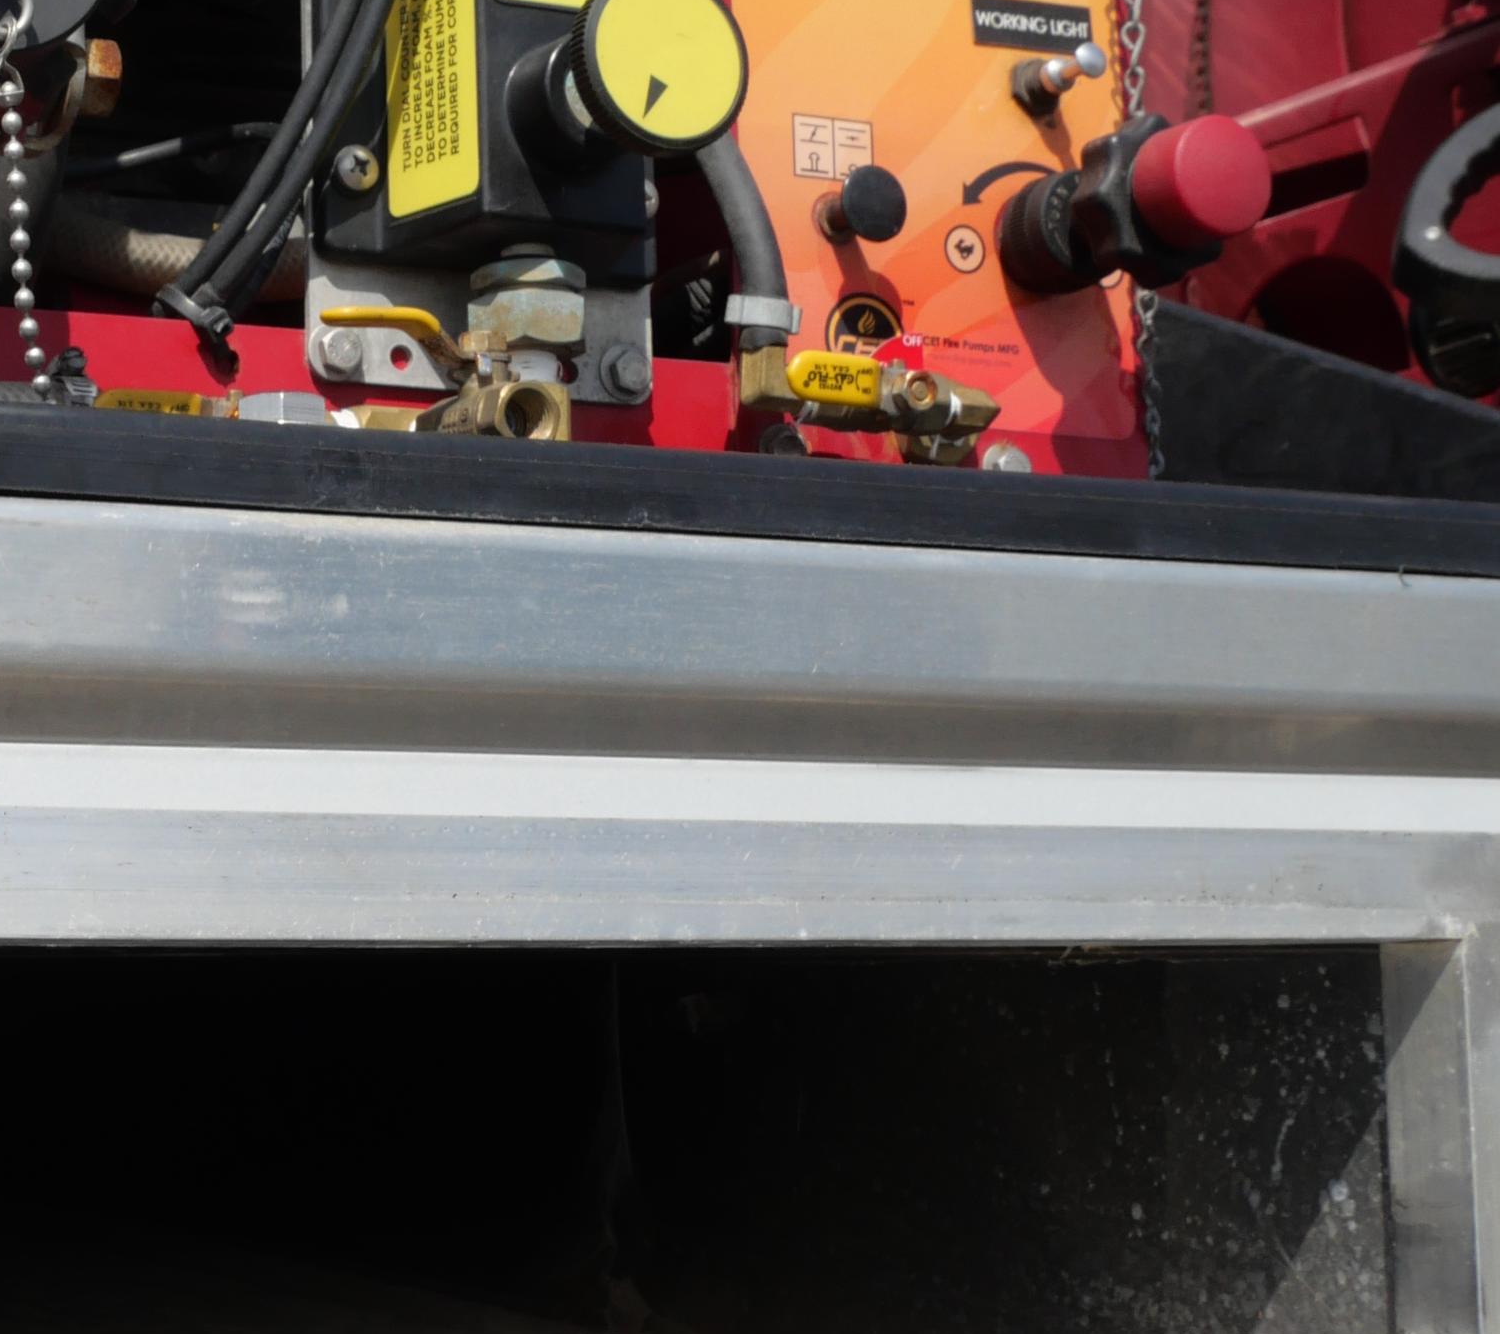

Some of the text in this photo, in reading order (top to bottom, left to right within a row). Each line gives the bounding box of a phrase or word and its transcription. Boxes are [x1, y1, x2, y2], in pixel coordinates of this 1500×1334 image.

[400, 5, 411, 82] COUNTER
[974, 9, 1089, 39] WORKING LIGHT
[423, 26, 434, 75] FOAM
[448, 33, 458, 67] FOR
[412, 59, 423, 141] INCREASE
[436, 38, 447, 134] DETERMINE
[401, 91, 411, 124] DIAL
[424, 76, 436, 164] DECREASE
[448, 72, 460, 156] REQUIRED
[402, 128, 412, 172] TURN
[414, 145, 423, 168] TO
[438, 137, 447, 161] TO
[902, 333, 923, 347] OFF
[923, 336, 942, 347] CET
[962, 340, 995, 353] Pumps
[997, 344, 1020, 356] MFG
